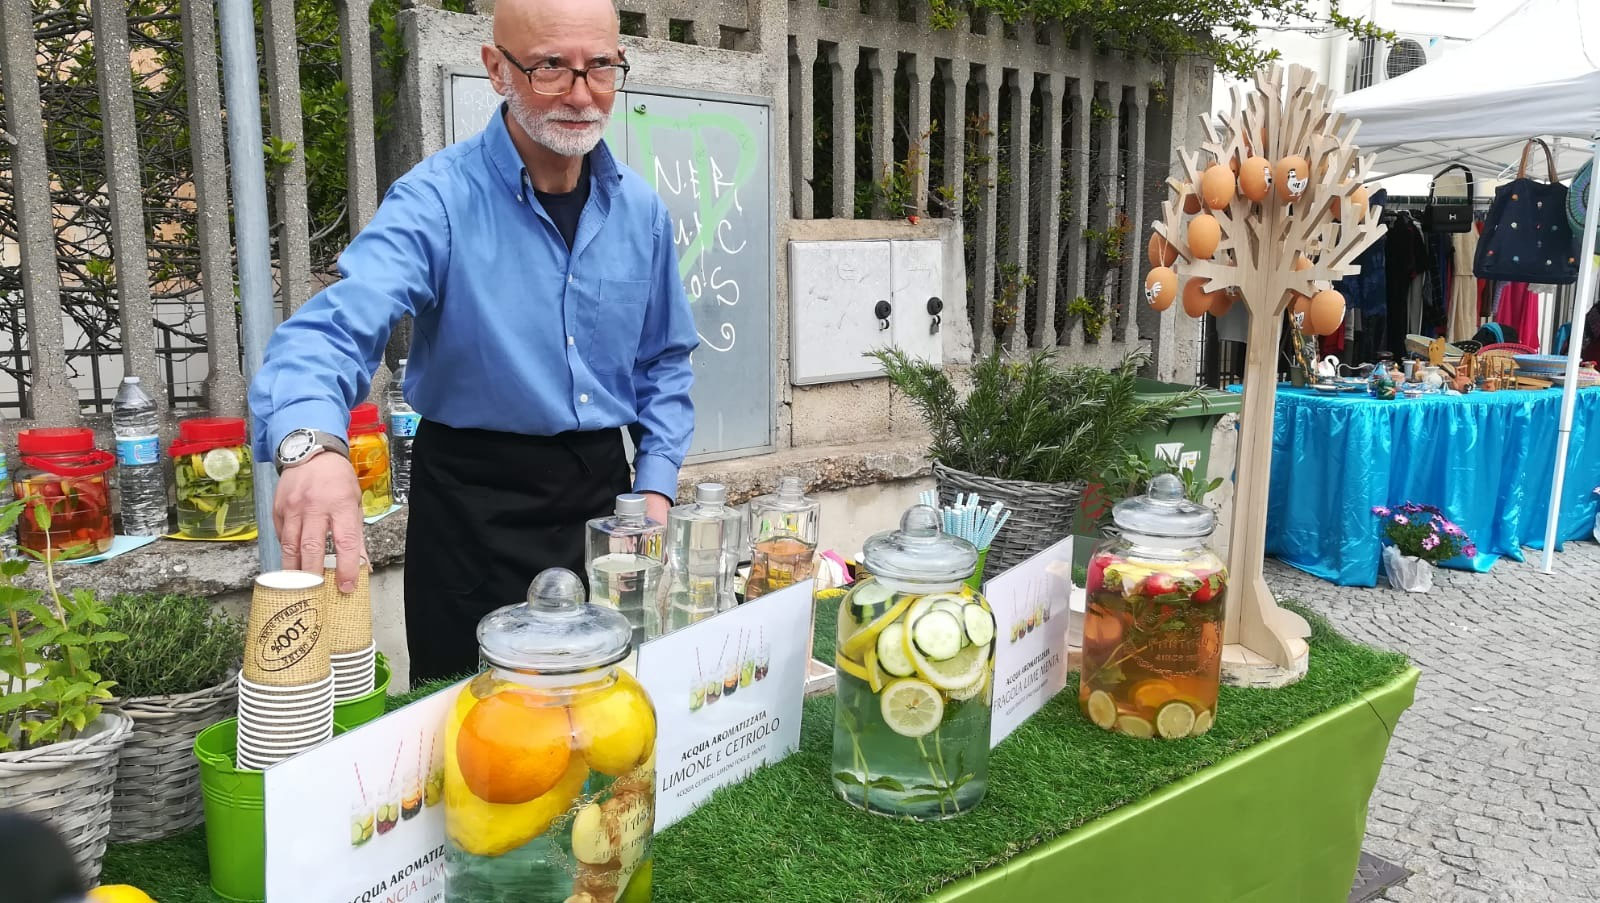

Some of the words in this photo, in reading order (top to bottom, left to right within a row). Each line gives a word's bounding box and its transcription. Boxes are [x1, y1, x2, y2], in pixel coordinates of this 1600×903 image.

[271, 617, 309, 654] 100%
[993, 681, 1023, 712] FRAGOLA
[662, 753, 713, 792] LIMONE
[716, 751, 722, 762] E
[725, 717, 780, 757] CETRIOLO
[681, 740, 710, 762] ACQUA
[711, 710, 767, 746] AROMATIZZATA
[348, 881, 387, 903] CQUA
[390, 844, 445, 887] AROMATIZ
[380, 880, 418, 903] NCIA
[422, 862, 445, 887] LIM
